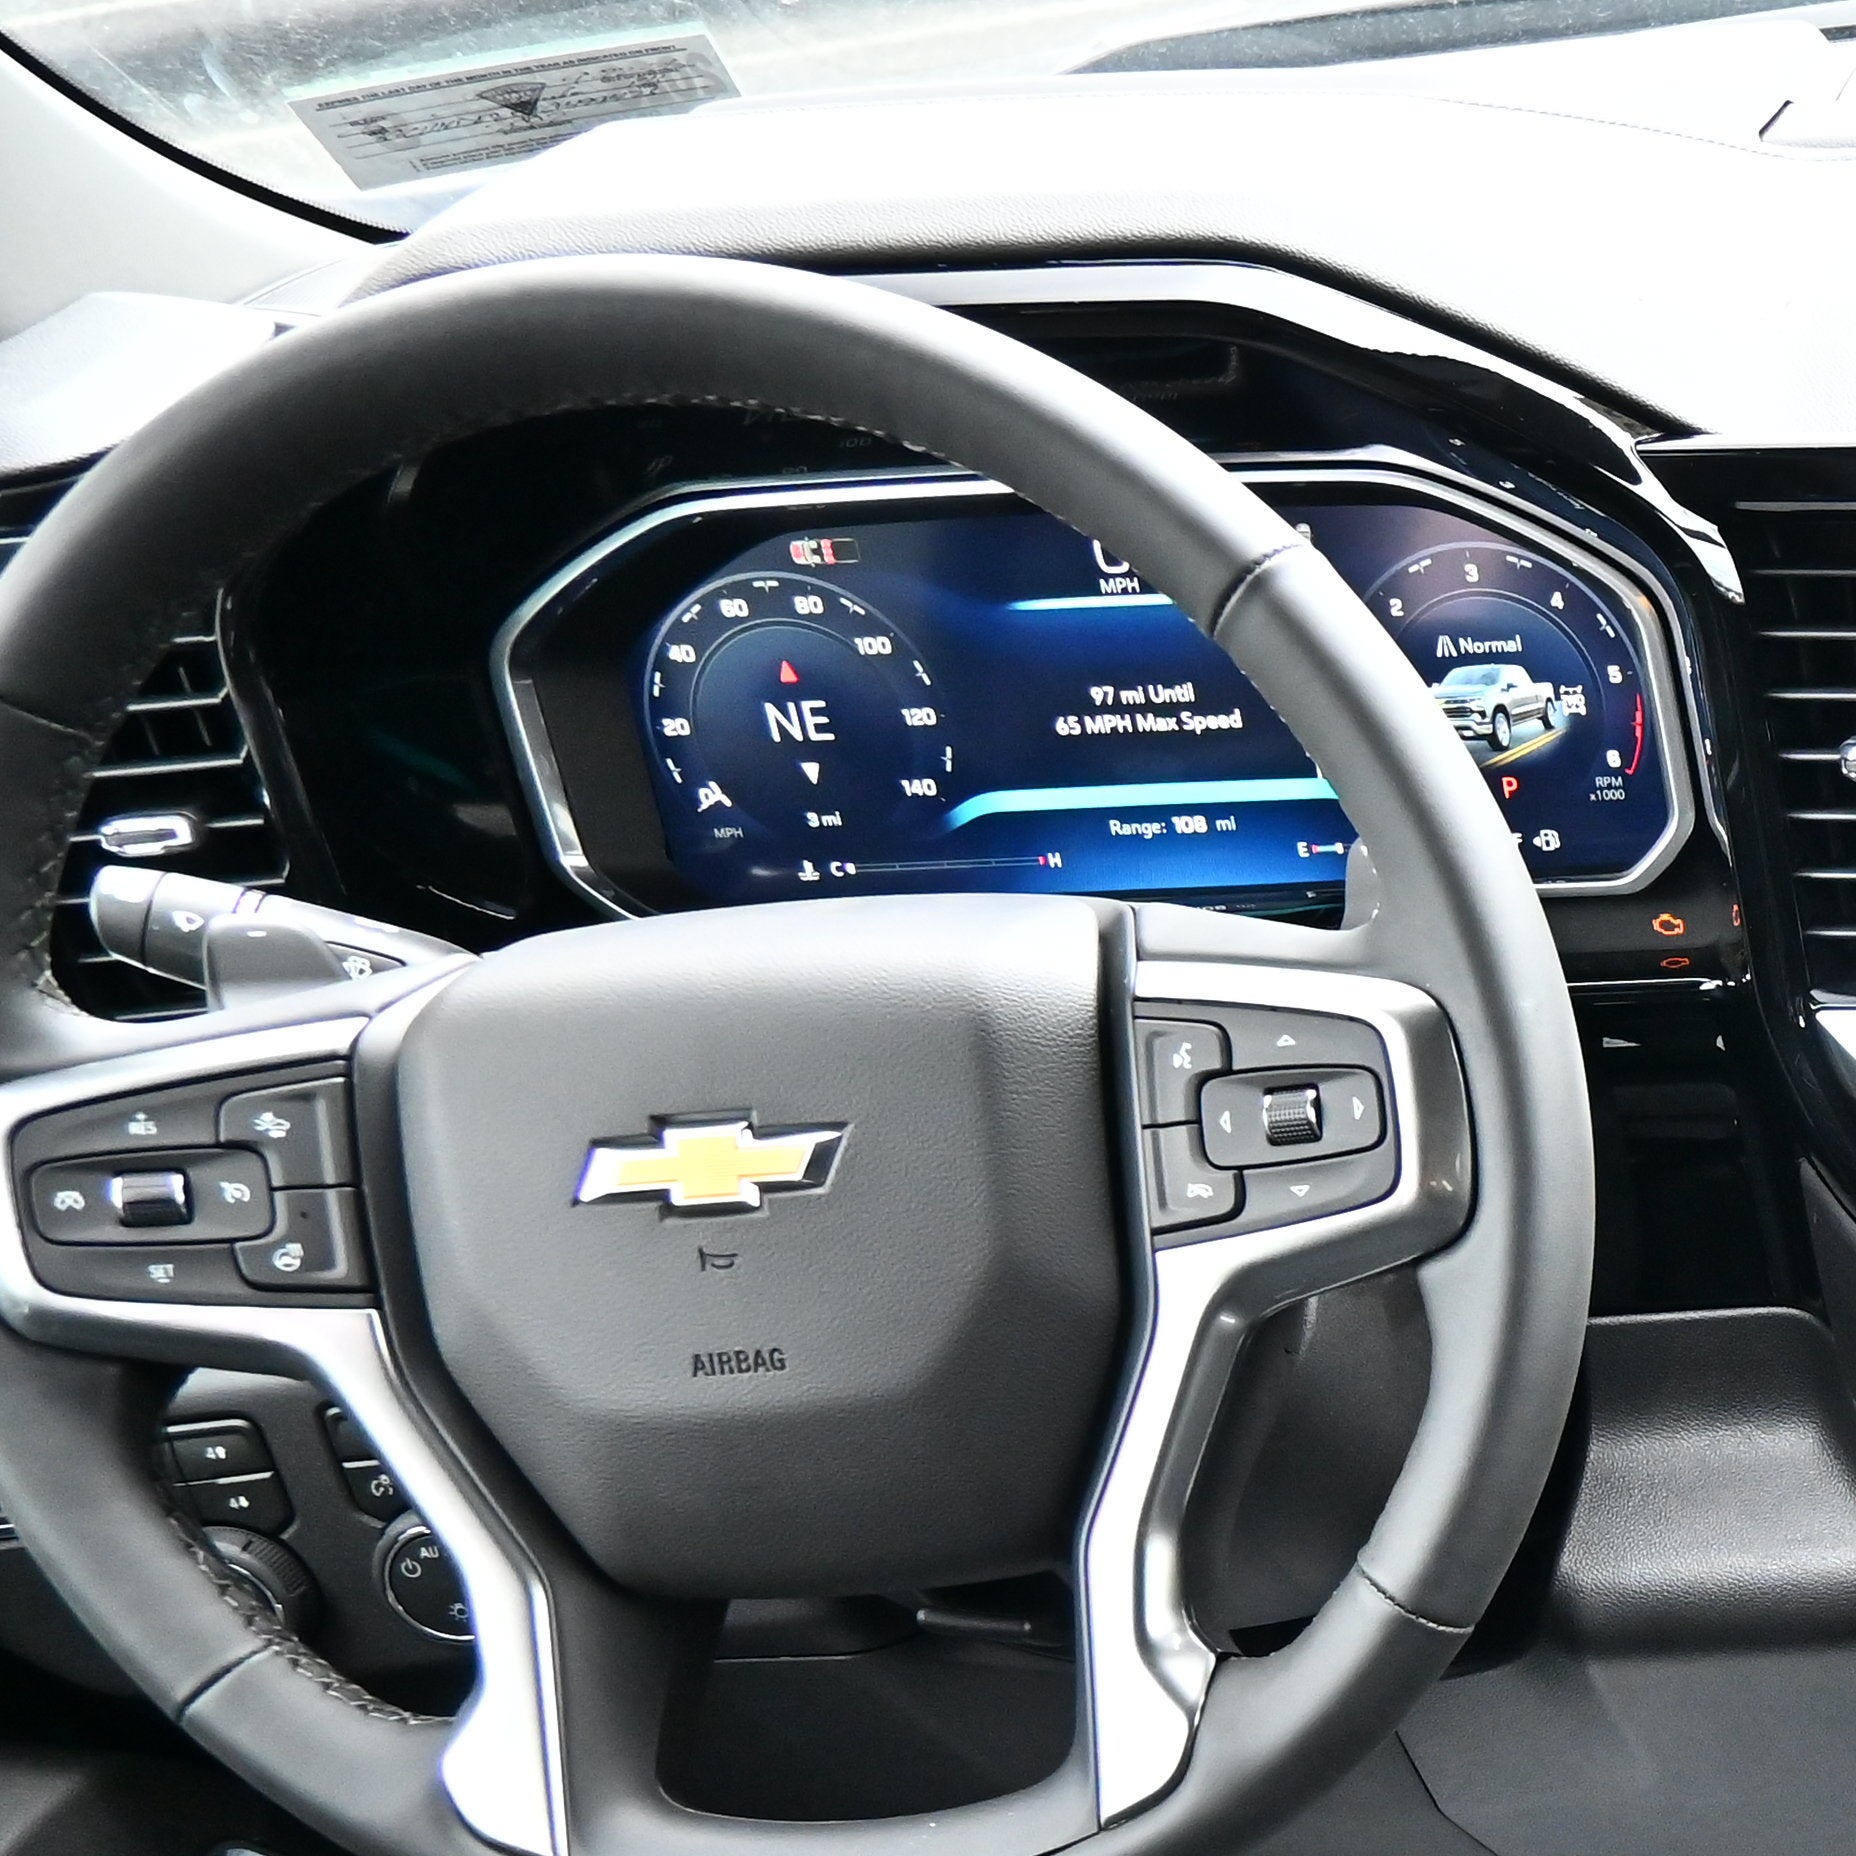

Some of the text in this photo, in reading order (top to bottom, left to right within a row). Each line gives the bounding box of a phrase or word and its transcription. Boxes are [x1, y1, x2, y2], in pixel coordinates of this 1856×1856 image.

[1464, 563, 1479, 583] 3
[1099, 577, 1140, 594] MPH
[720, 598, 749, 618] 60
[793, 596, 824, 615] 80
[1389, 598, 1404, 616] 2
[1550, 592, 1565, 609] 4
[667, 644, 696, 663] 40
[854, 636, 892, 656] 100
[1460, 635, 1523, 655] Normal
[1607, 665, 1622, 684] 5
[1089, 682, 1195, 707] 97 mi Until
[763, 700, 836, 743] NE
[901, 706, 937, 726] 120
[1055, 709, 1243, 737] 65 MPH Max Speed
[661, 716, 690, 736] 20
[901, 778, 937, 797] 140
[1502, 776, 1519, 799] P
[1595, 776, 1624, 788] RPM
[1589, 790, 1626, 801] x1000
[823, 811, 843, 827] mi
[1109, 819, 1166, 839] Range:
[1216, 816, 1237, 832] mi
[713, 826, 744, 840] MPH
[1296, 841, 1309, 857] E
[1048, 852, 1062, 868] H
[692, 1347, 788, 1377] AIRBAG
